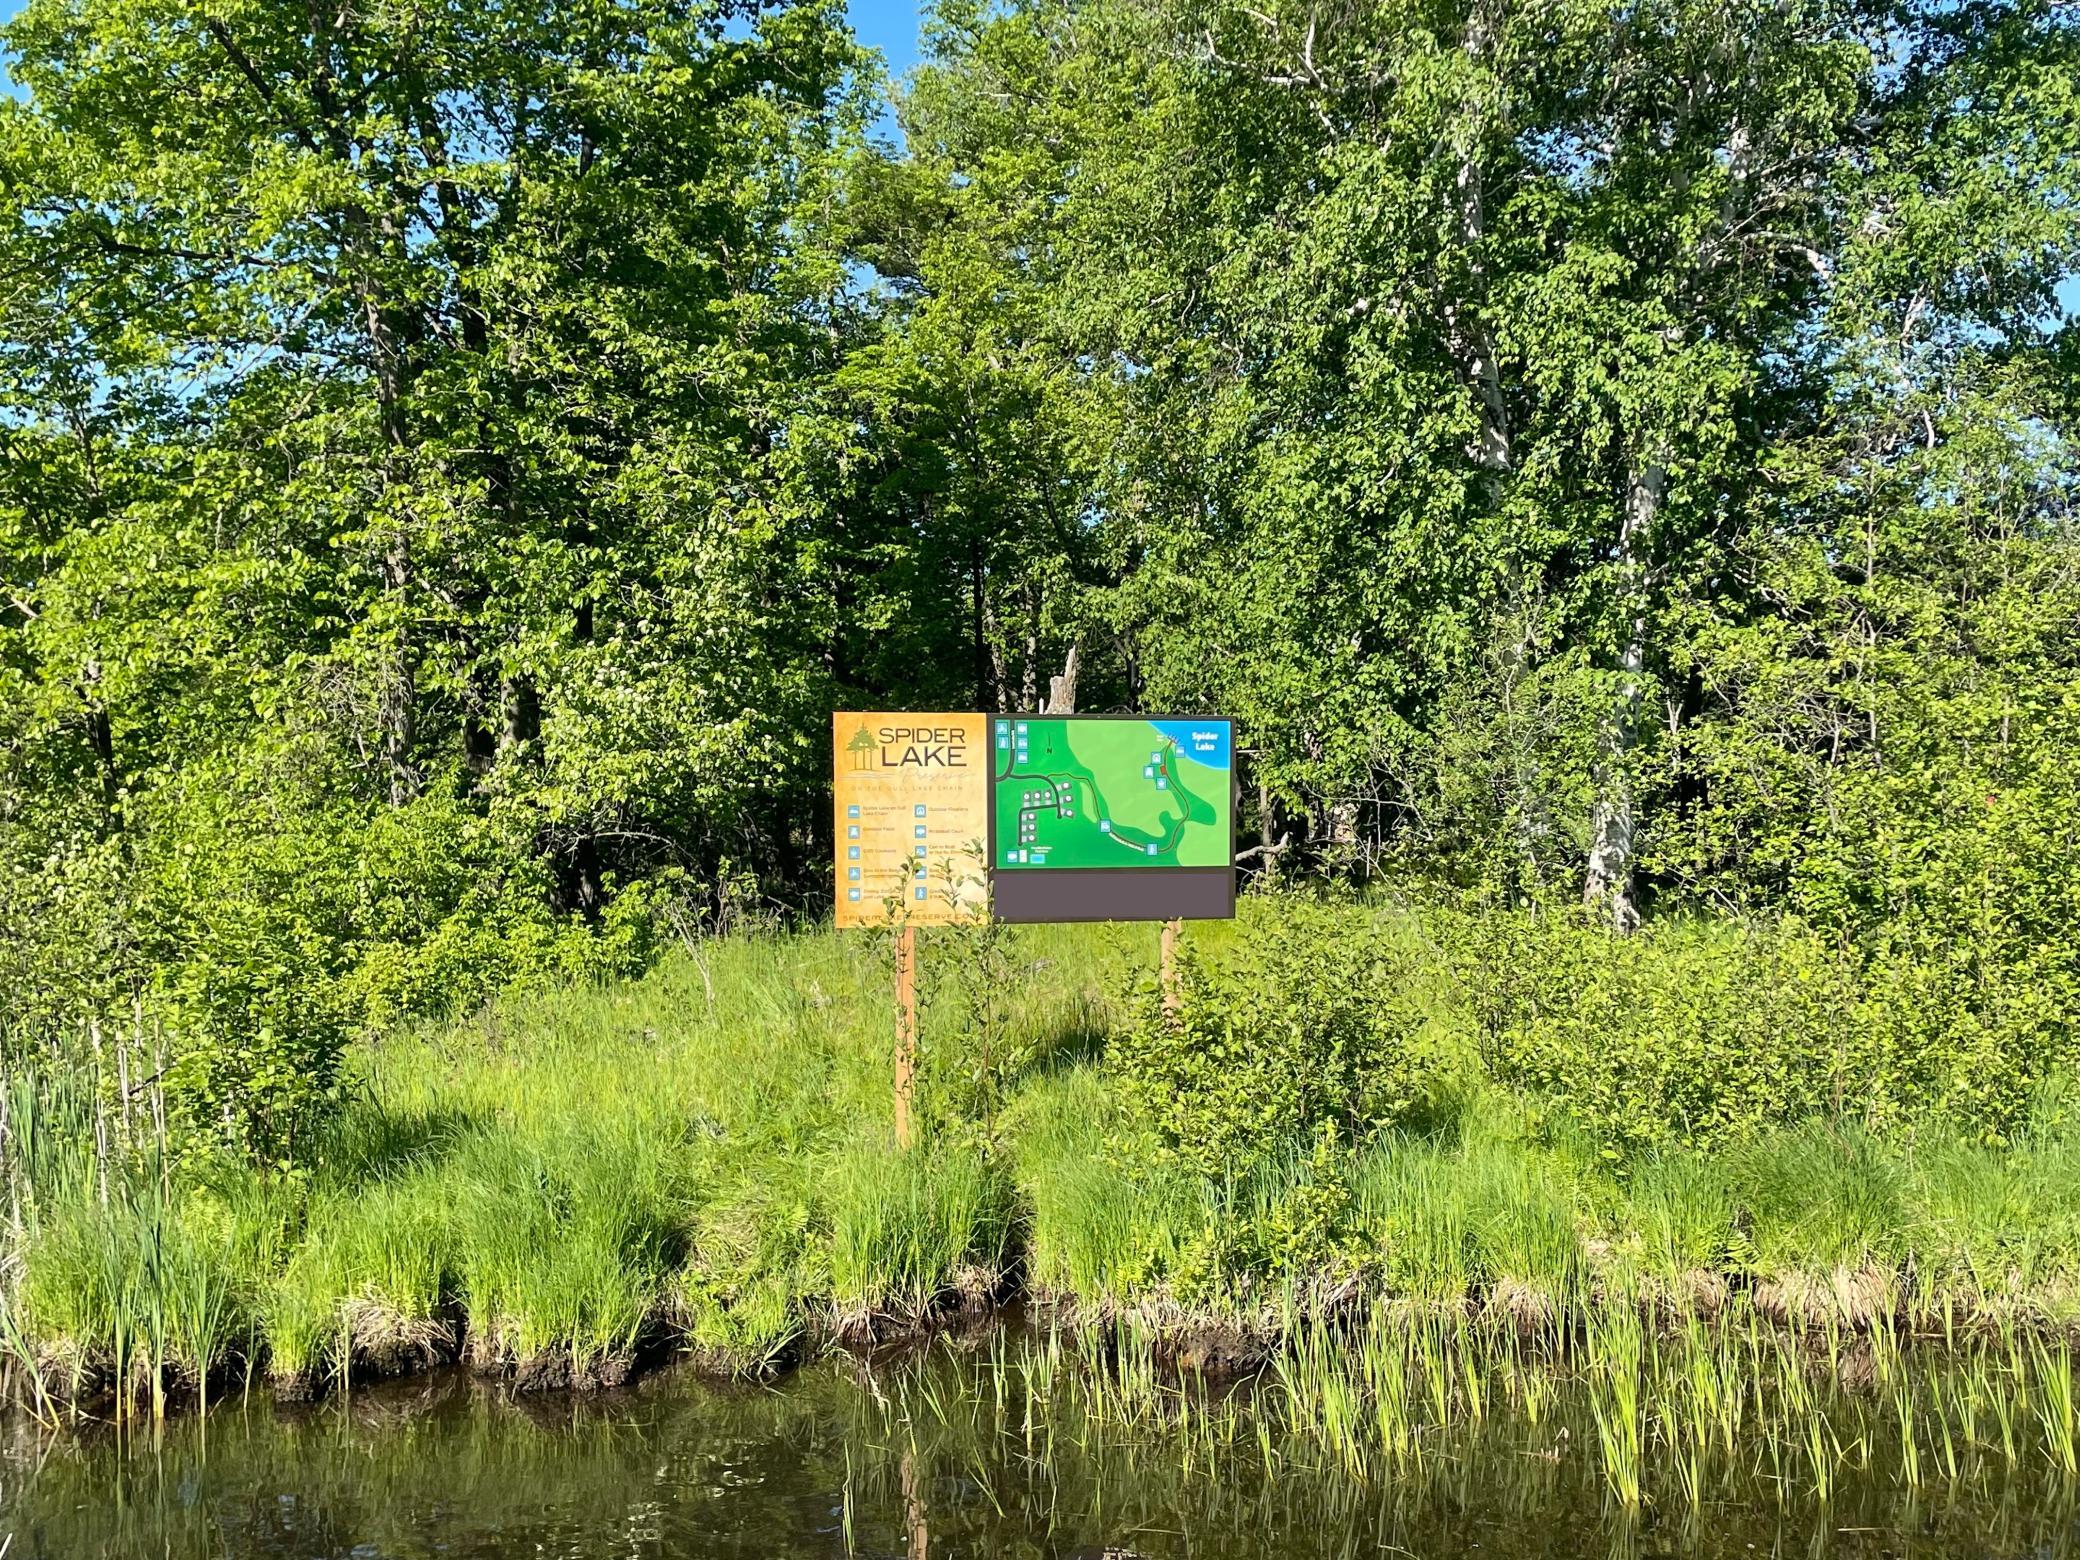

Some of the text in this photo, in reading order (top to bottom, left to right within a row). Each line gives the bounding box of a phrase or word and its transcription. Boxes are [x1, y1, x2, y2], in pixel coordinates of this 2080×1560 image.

[879, 727, 966, 744] SPIDER
[1191, 731, 1219, 742] Spider
[1195, 742, 1216, 751] Lake
[881, 746, 968, 767] LAKE
